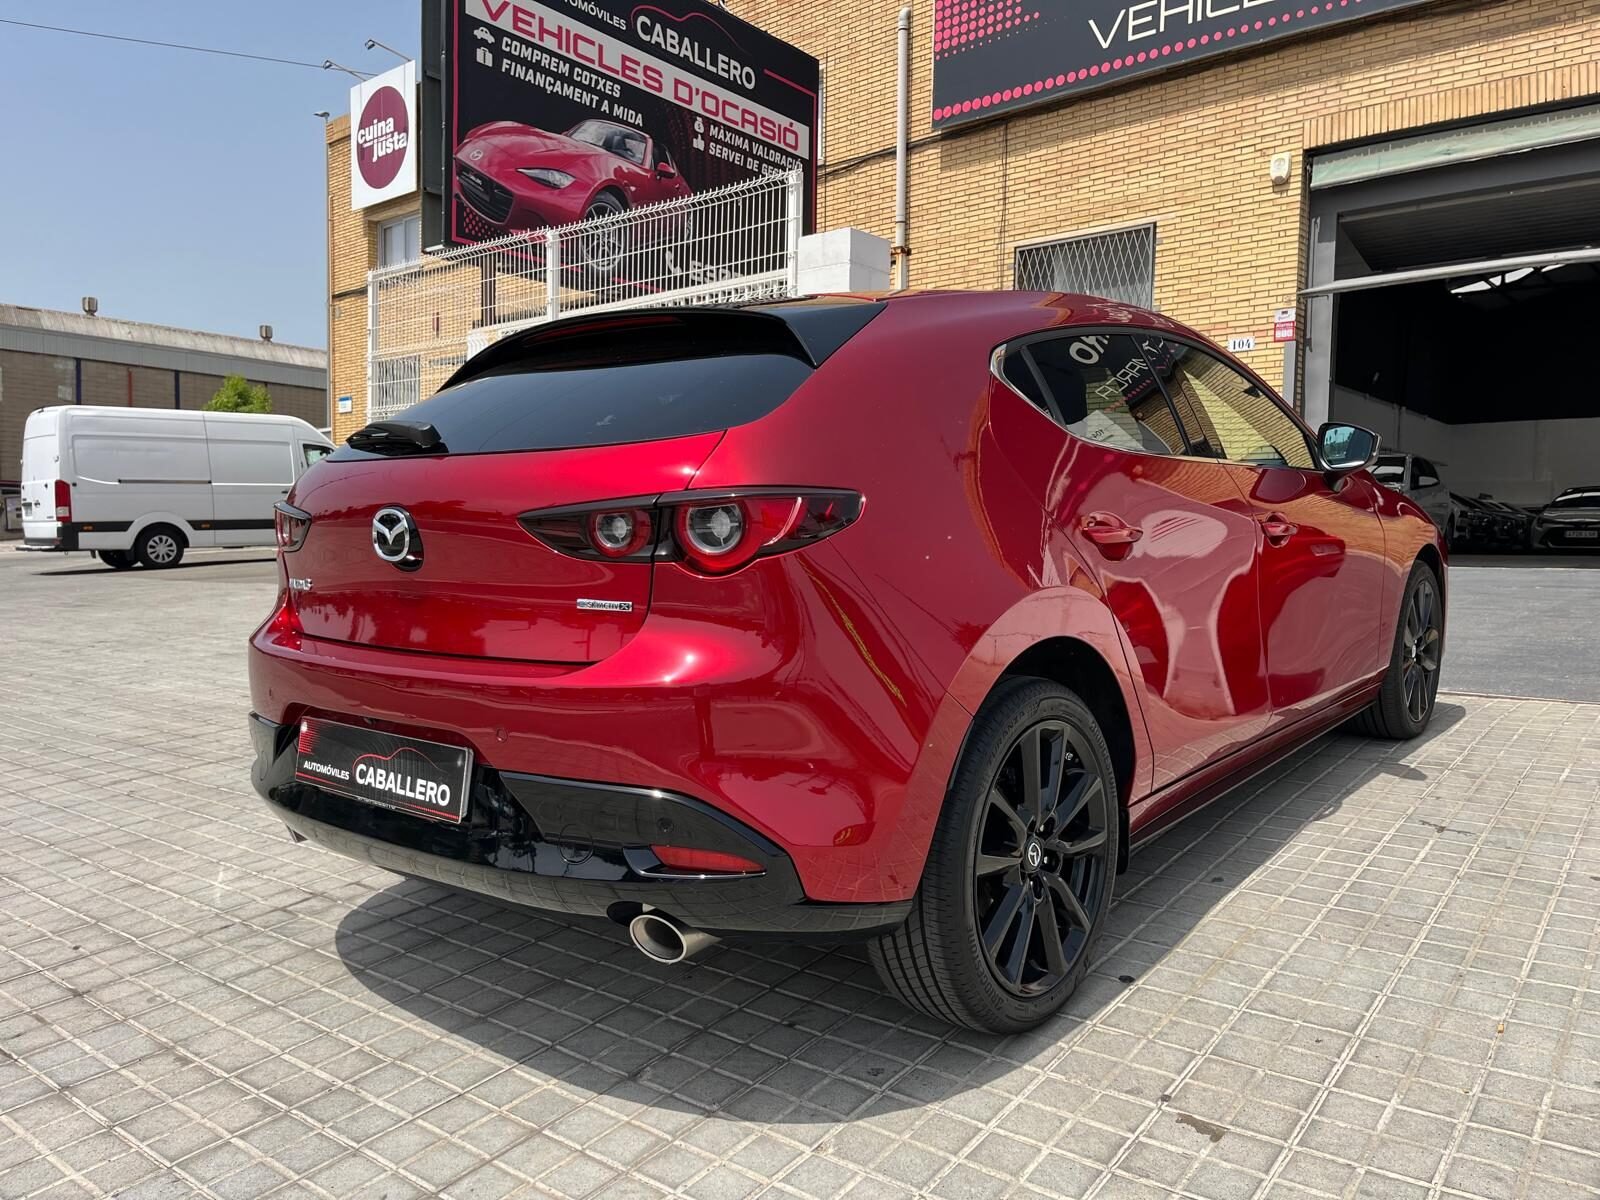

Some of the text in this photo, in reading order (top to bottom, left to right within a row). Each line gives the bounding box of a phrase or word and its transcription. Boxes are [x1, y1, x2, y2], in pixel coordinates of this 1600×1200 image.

[565, 0, 756, 90] OMÓVILES CABALLERO
[481, 0, 799, 151] VEHICLES D'OCASIÓ
[501, 37, 621, 98] COMPREM COTXES
[501, 58, 643, 127] FINANÇAMENT A MIDA
[357, 117, 394, 144] cuina
[372, 131, 407, 163] justa
[709, 124, 749, 151] MÀXIMA
[708, 142, 744, 167] SERVEI
[746, 157, 759, 172] DE
[1232, 339, 1251, 350] 104
[303, 760, 350, 781] AUTOMÓVILES
[355, 763, 451, 807] CABALLERO
